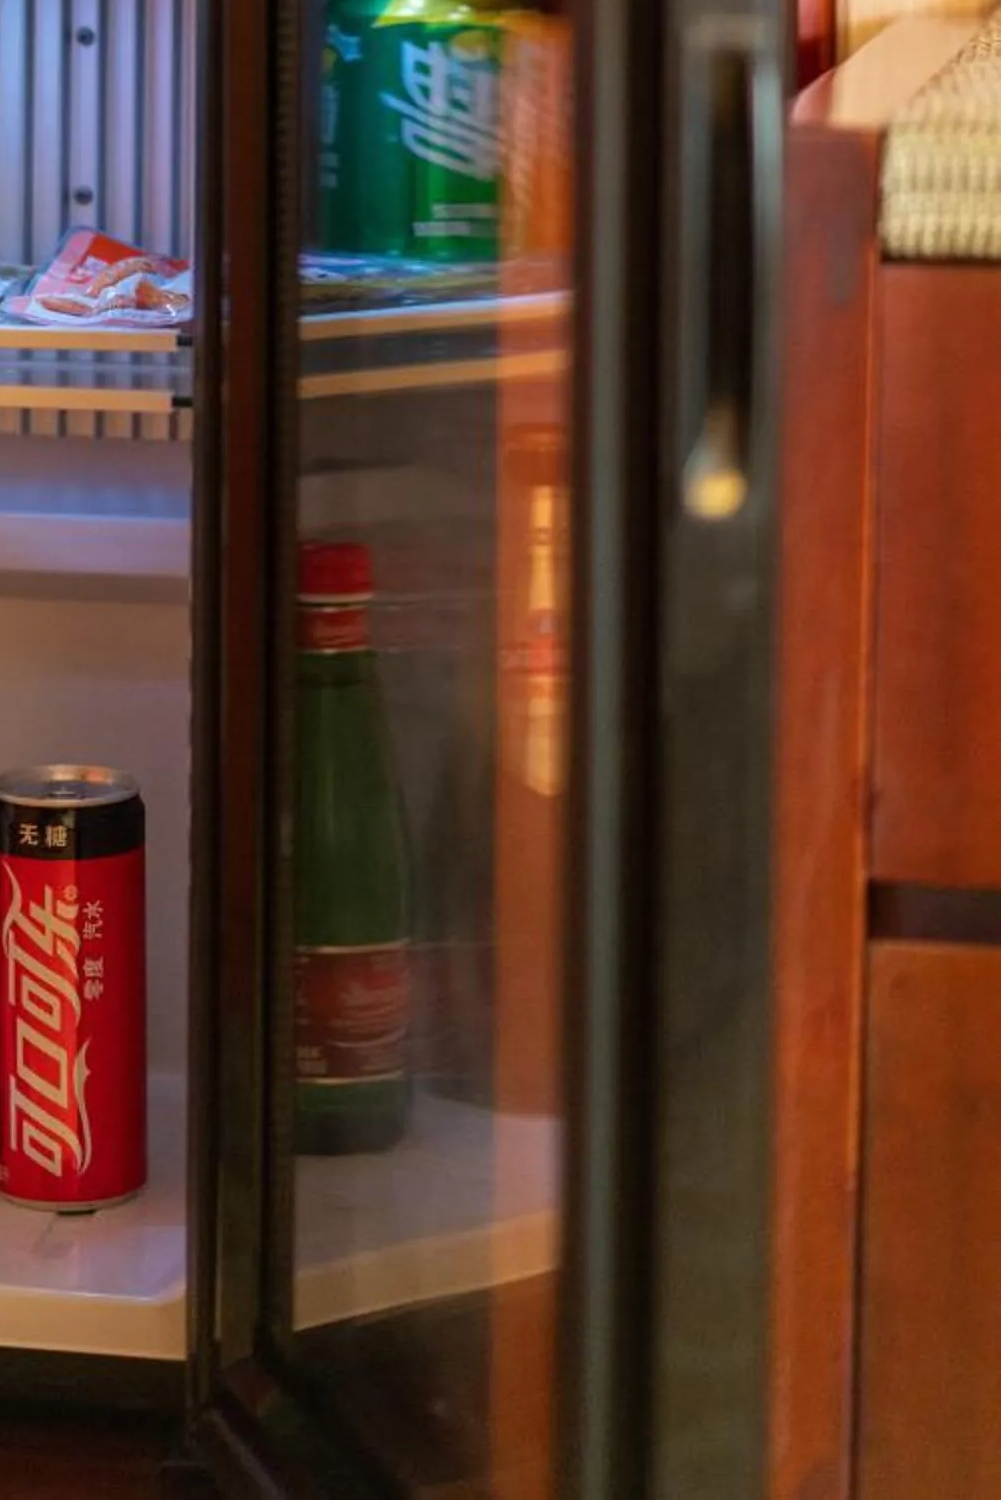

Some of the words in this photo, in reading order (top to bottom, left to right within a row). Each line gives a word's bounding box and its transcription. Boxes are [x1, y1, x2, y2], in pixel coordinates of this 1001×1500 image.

[19, 822, 67, 849] 无糖
[82, 900, 104, 940] 汽水
[3, 862, 85, 1178] 可口可乐
